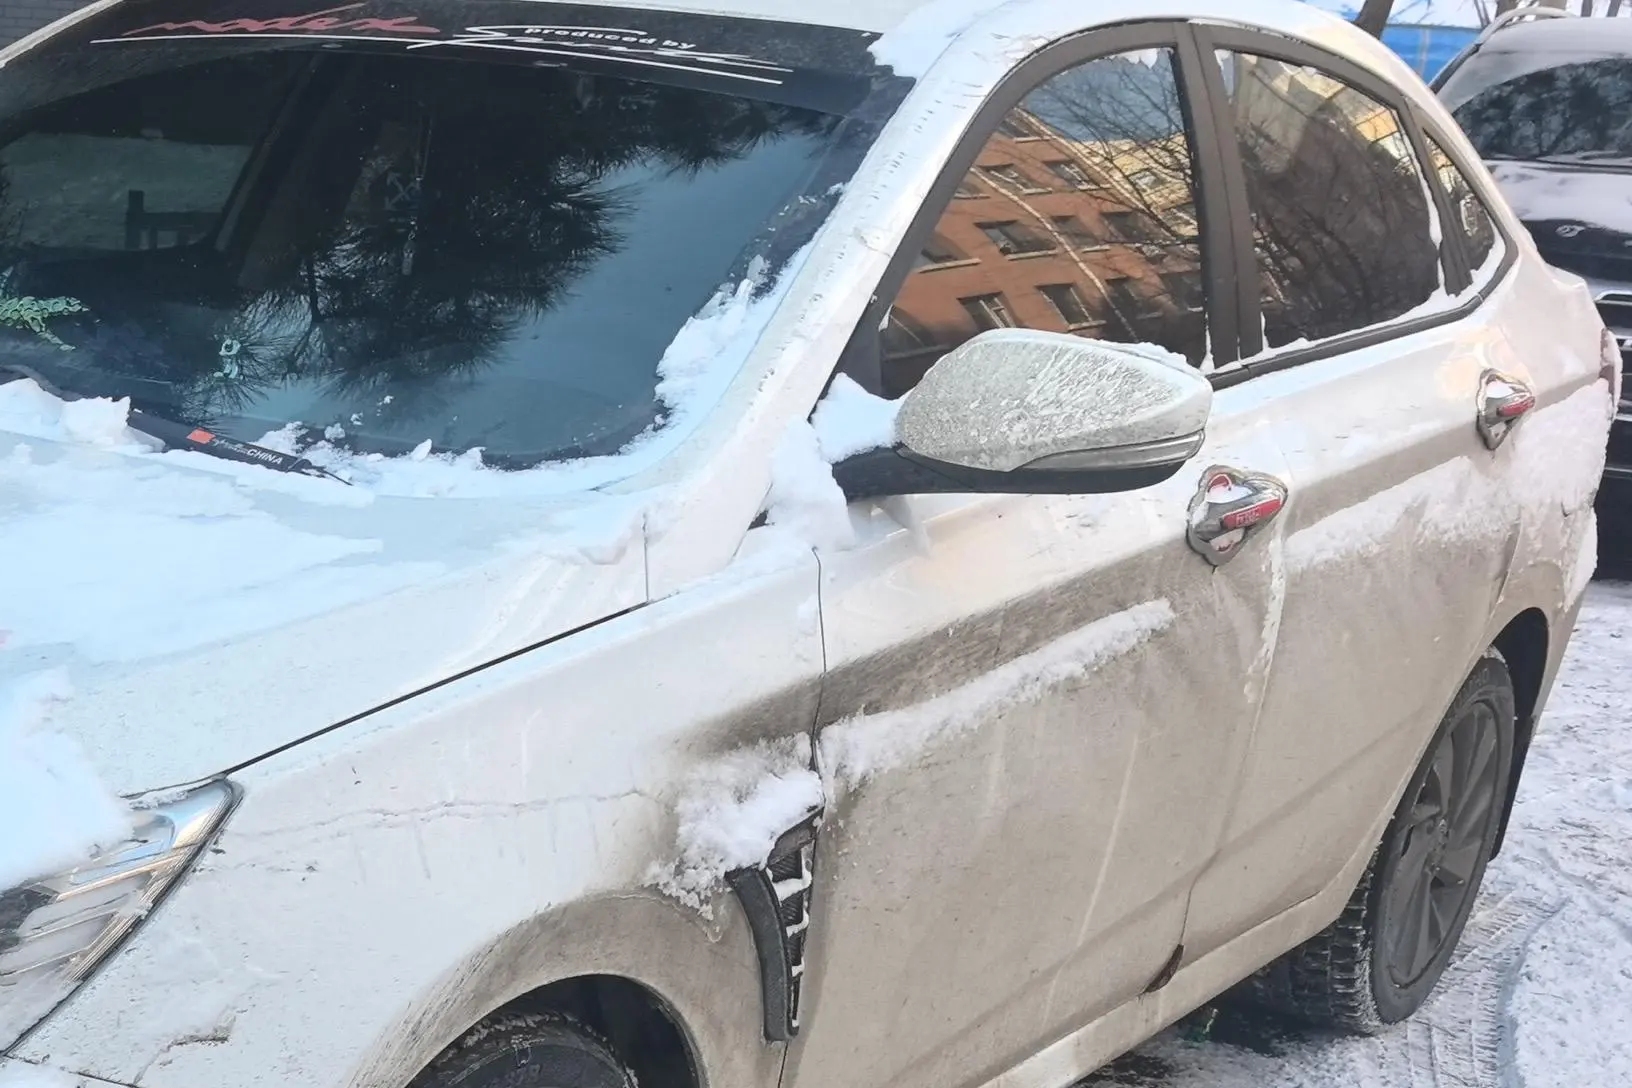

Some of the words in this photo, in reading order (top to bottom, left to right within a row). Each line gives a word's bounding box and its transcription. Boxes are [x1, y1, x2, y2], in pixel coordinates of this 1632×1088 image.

[523, 27, 649, 45] produced
[662, 39, 697, 50] by
[246, 447, 283, 465] CHINA
